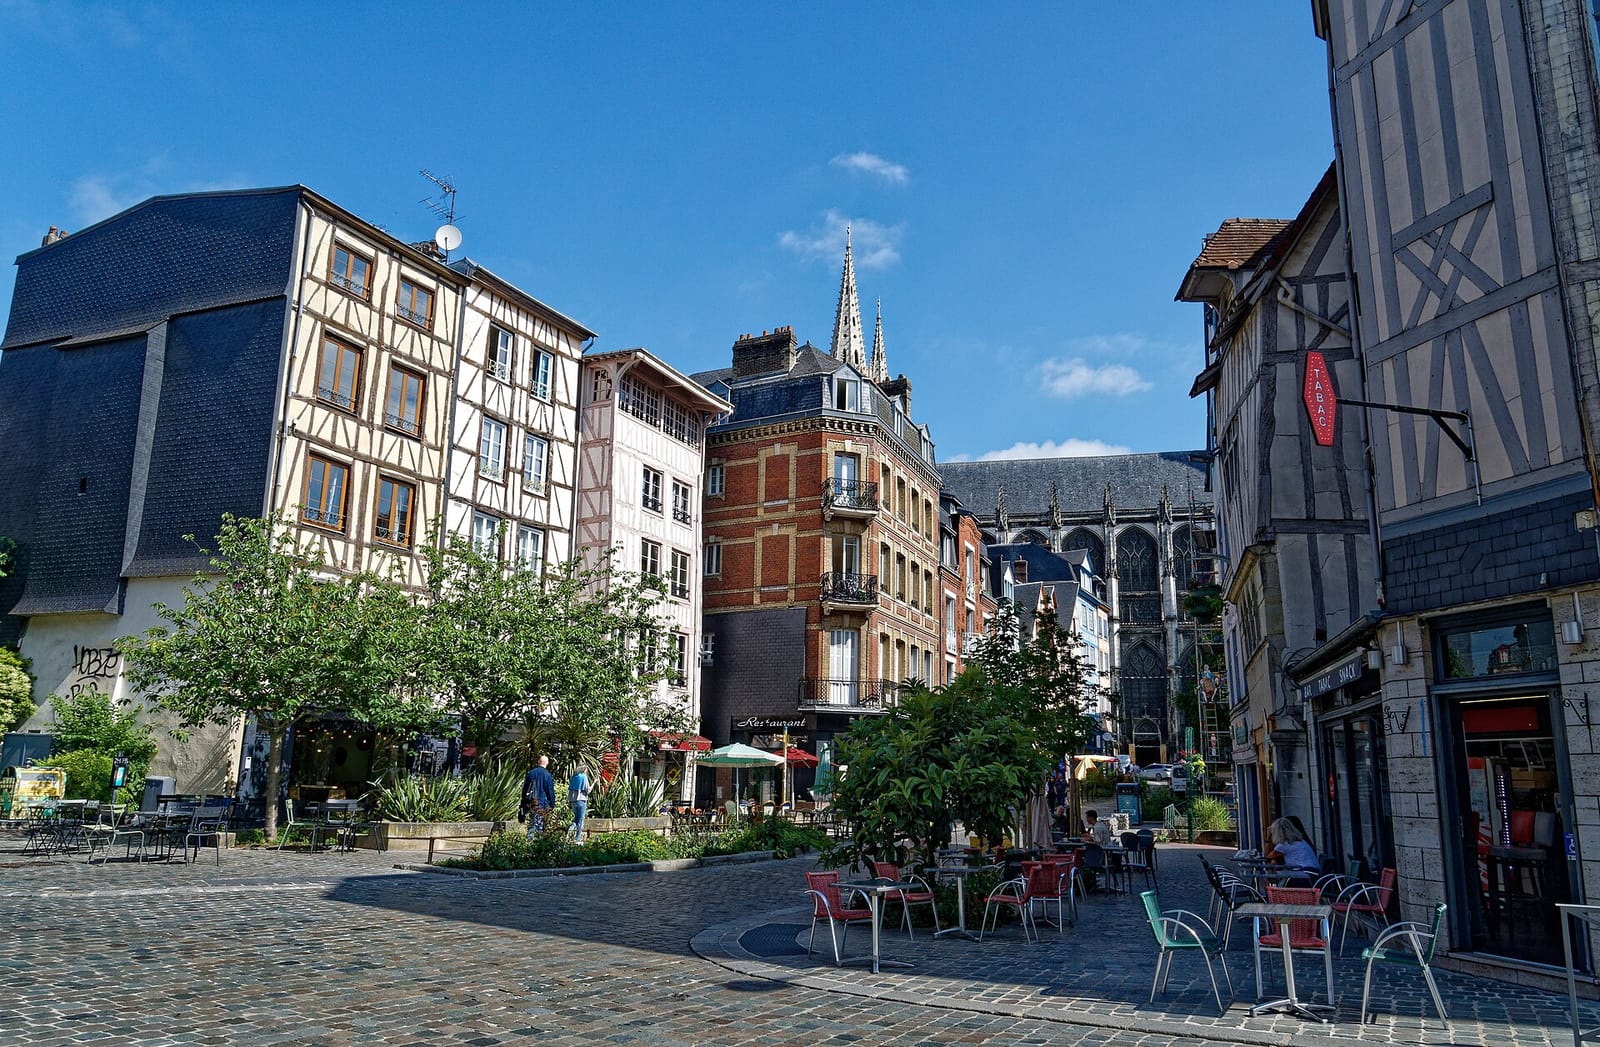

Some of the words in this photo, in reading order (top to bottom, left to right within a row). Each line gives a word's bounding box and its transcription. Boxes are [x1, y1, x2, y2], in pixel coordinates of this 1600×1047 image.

[1314, 368, 1327, 427] TABAC
[1304, 684, 1313, 698] BAR
[1318, 675, 1331, 692] TABAC
[1339, 663, 1355, 683] SNACK
[737, 716, 806, 727] Restaurant
